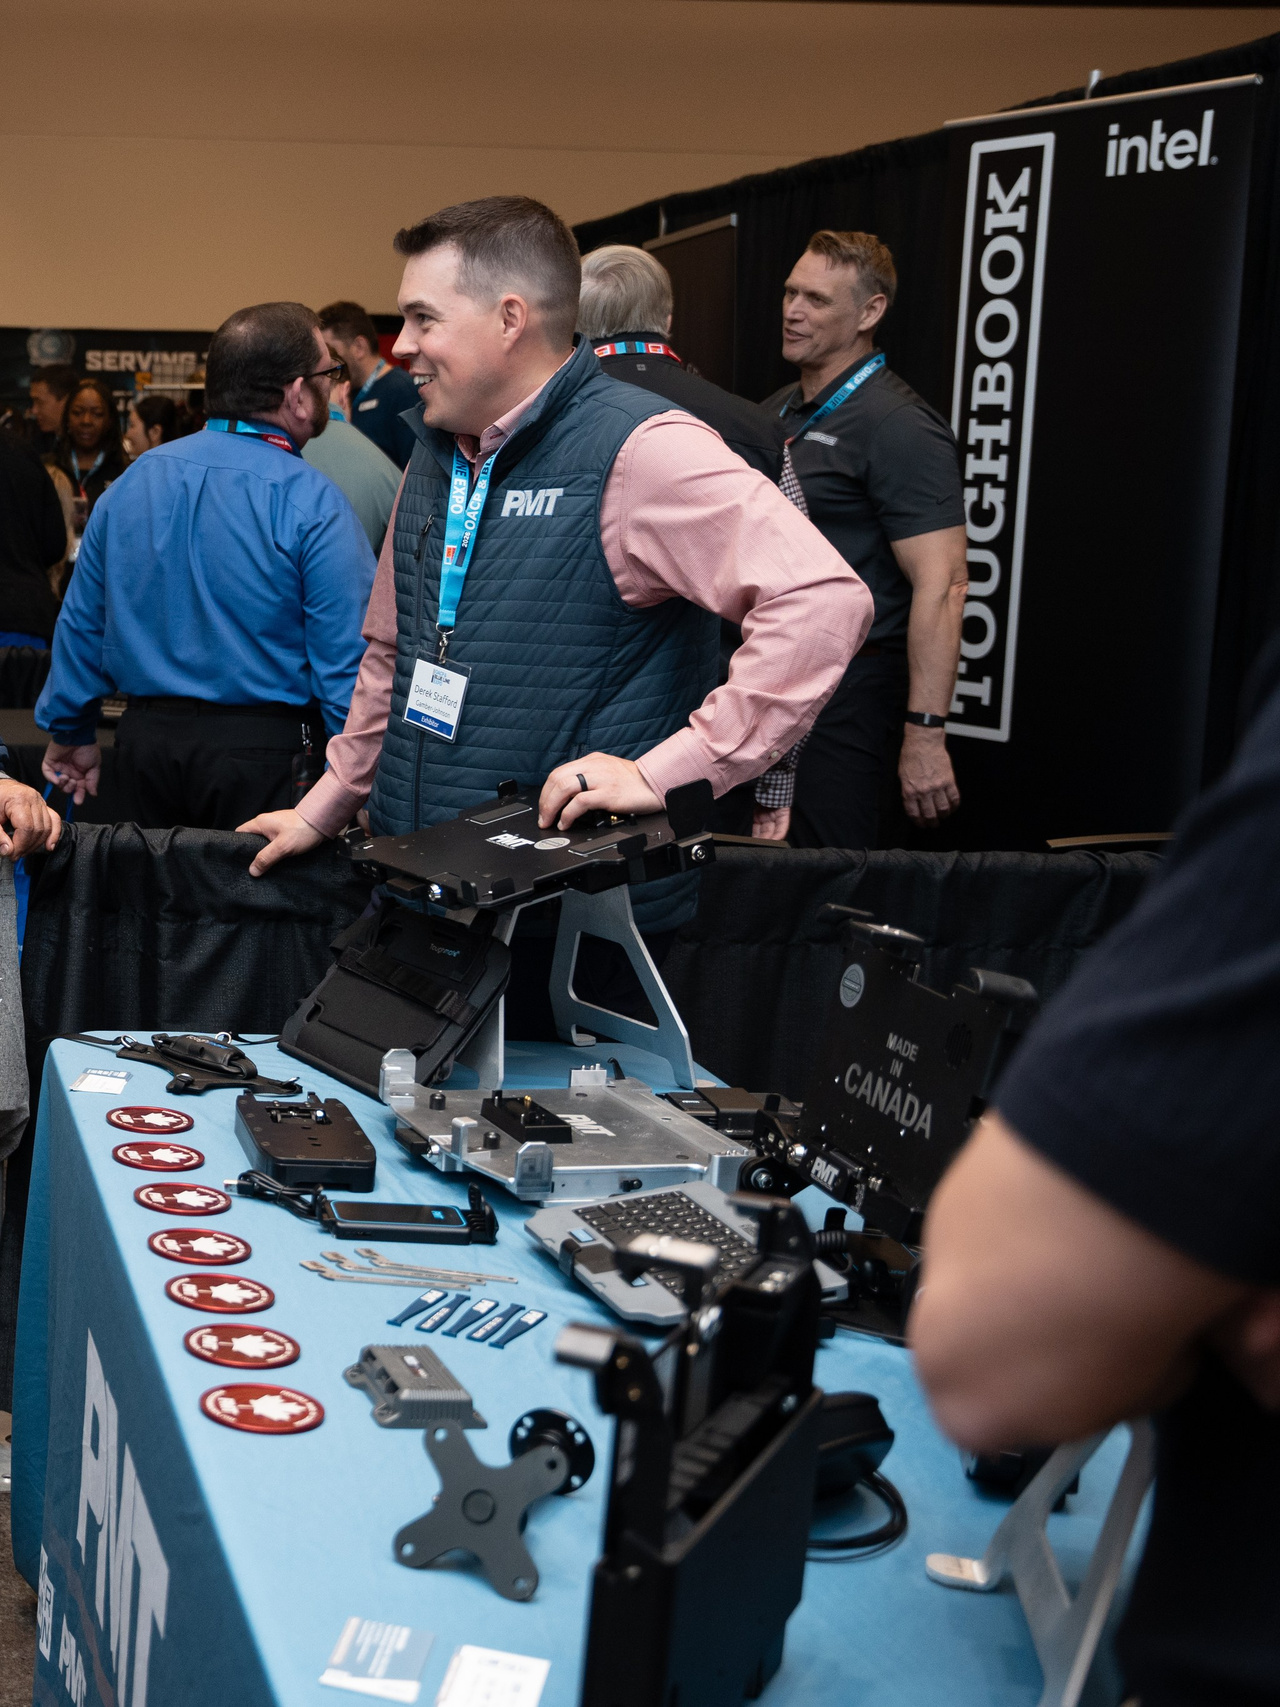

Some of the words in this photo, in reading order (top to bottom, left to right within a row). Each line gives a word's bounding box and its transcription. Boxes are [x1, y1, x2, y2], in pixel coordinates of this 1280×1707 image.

[1105, 109, 1214, 177] intel
[949, 167, 1031, 714] TOUGHBOOK
[450, 478, 467, 514] EXPO
[464, 493, 481, 531] OACP
[477, 478, 487, 489] &
[501, 488, 564, 517] PMT
[414, 685, 433, 699] Derek
[433, 691, 458, 709] Stafford
[420, 716, 440, 728] Exhibitor
[487, 833, 536, 848] PMT
[886, 1032, 919, 1062] MADE
[889, 1058, 904, 1079] IN
[844, 1062, 933, 1140] CANADA
[811, 1156, 840, 1186] PMT
[76, 1327, 170, 1707] PMT
